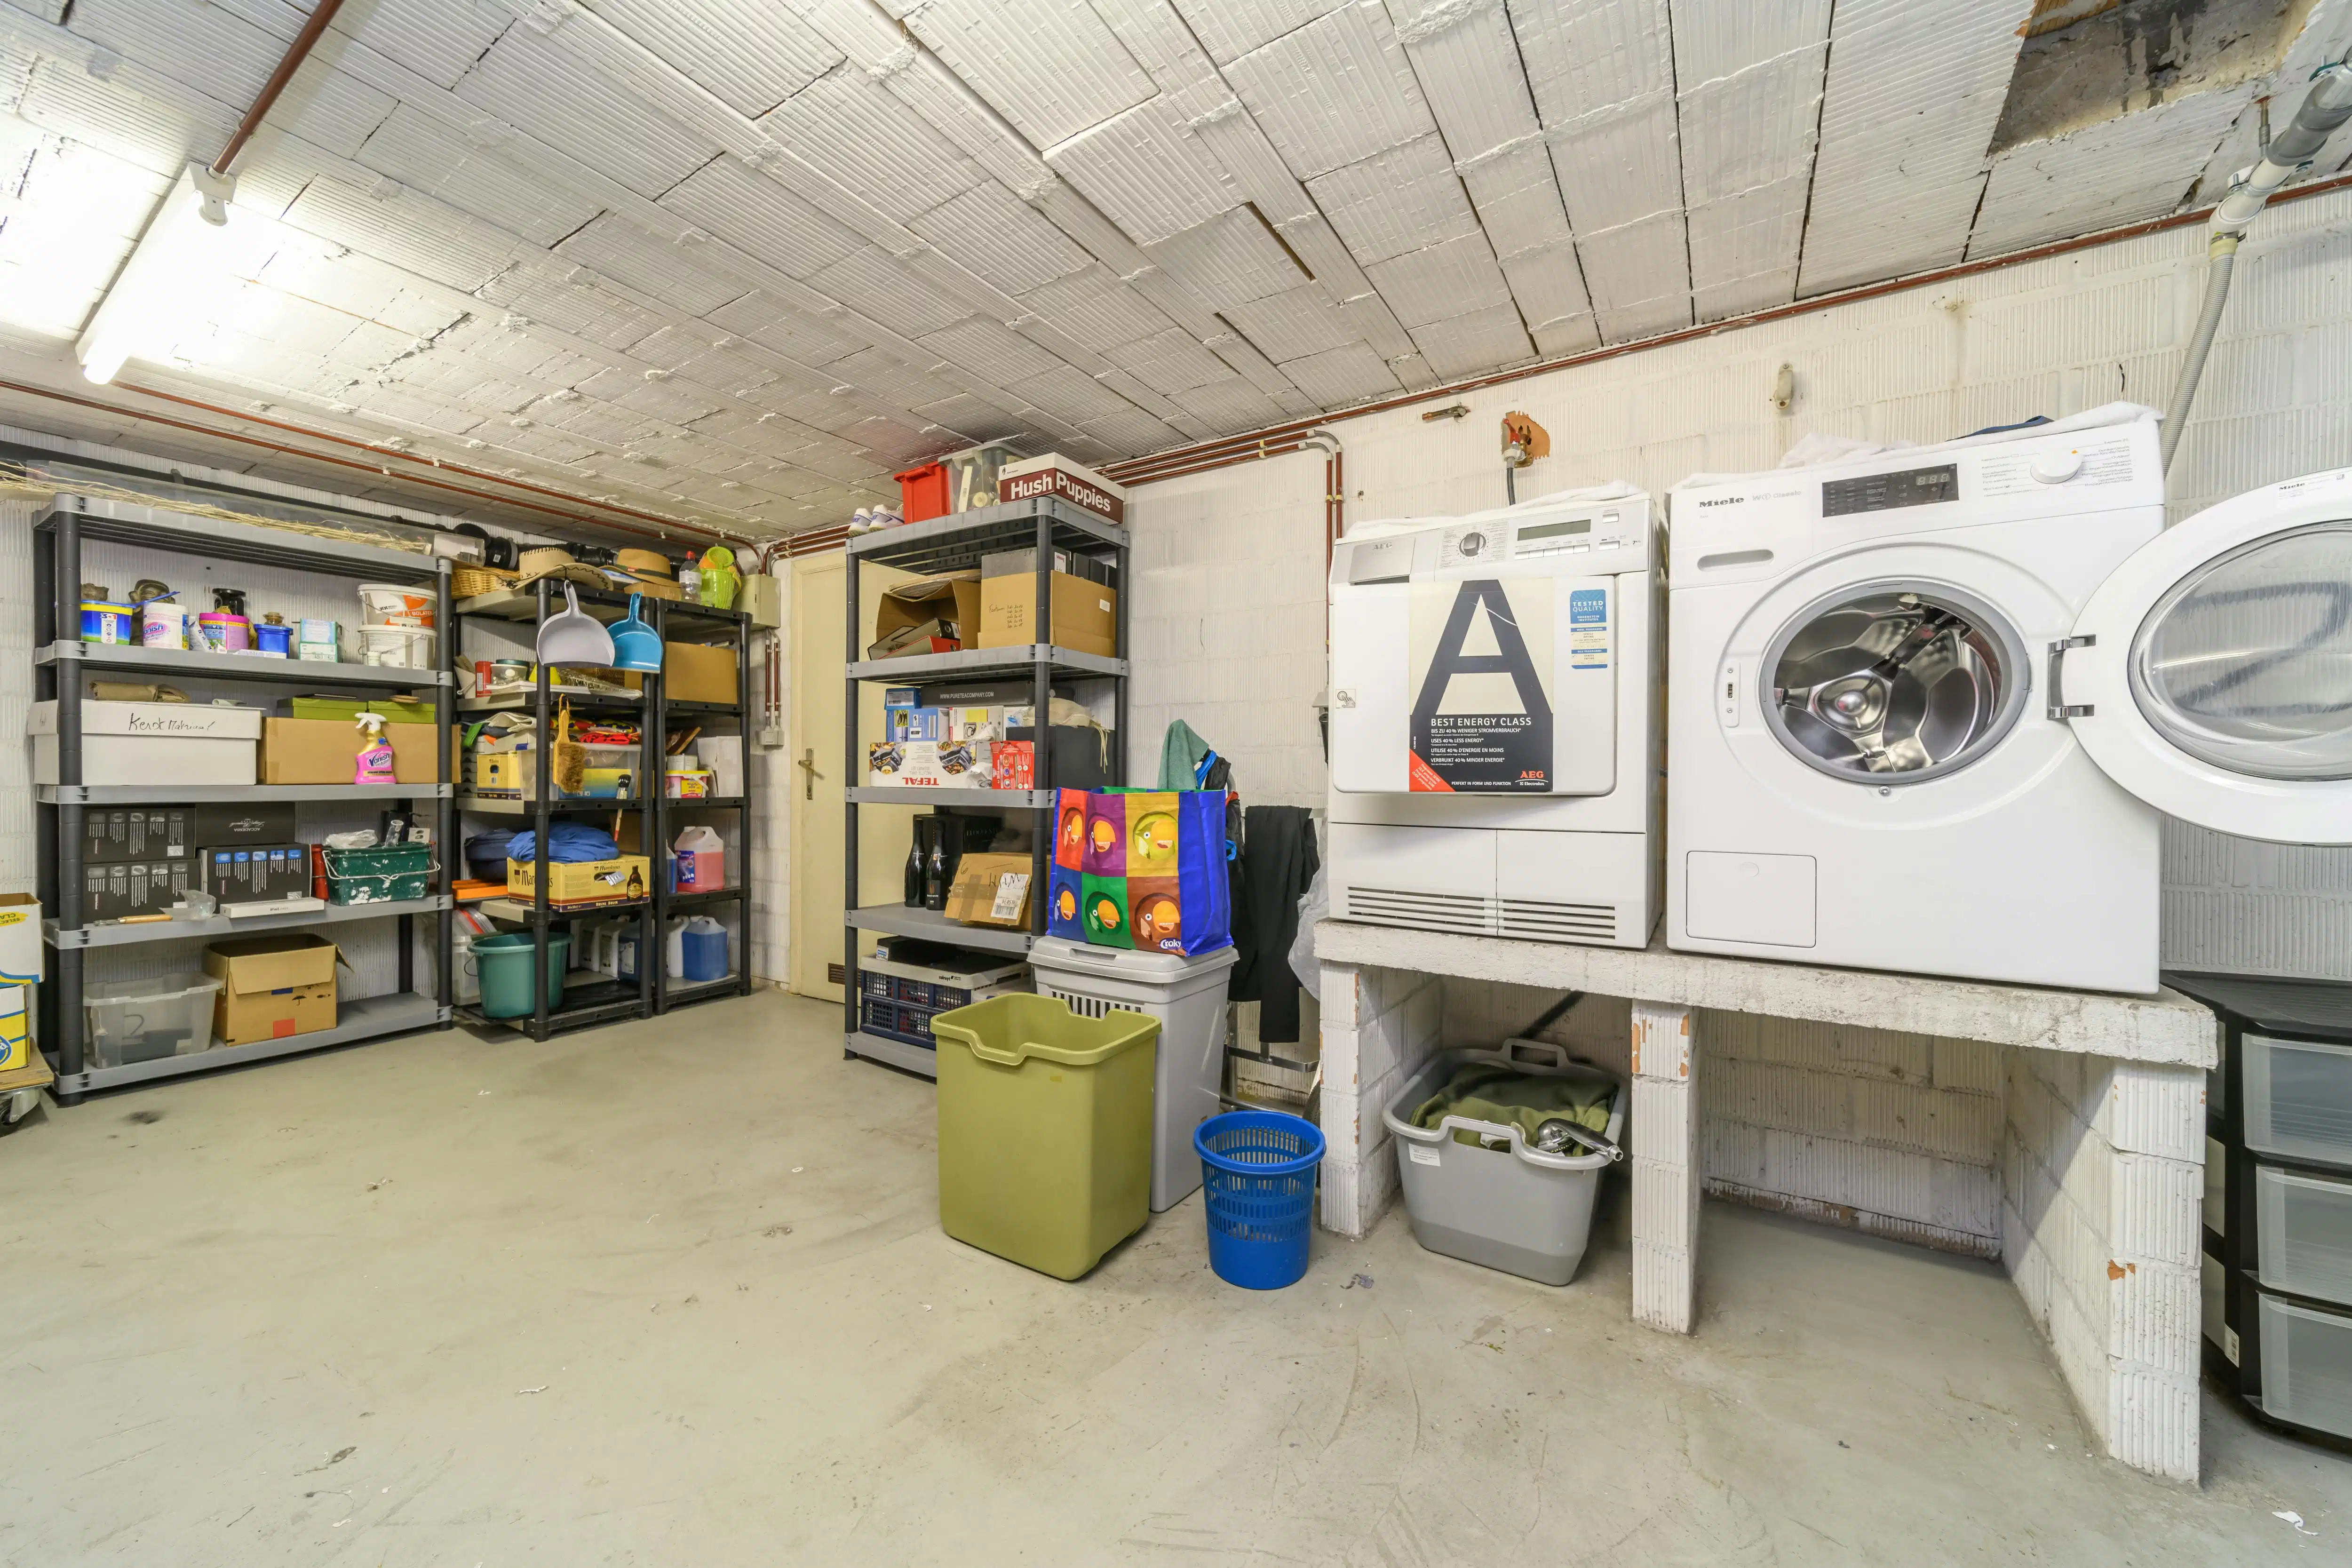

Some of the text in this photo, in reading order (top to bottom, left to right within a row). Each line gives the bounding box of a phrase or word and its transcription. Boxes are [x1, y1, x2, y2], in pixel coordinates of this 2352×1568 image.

[1011, 471, 1111, 512] Hush Puppies
[1699, 497, 1744, 508] Miele
[1373, 542, 1393, 550] AEG
[143, 623, 164, 634] anish
[1411, 579, 1554, 715] A
[1500, 717, 1532, 725] CLASS
[369, 751, 389, 767] Vanish
[902, 777, 939, 786] TEFAL
[1160, 939, 1181, 949] Croky
